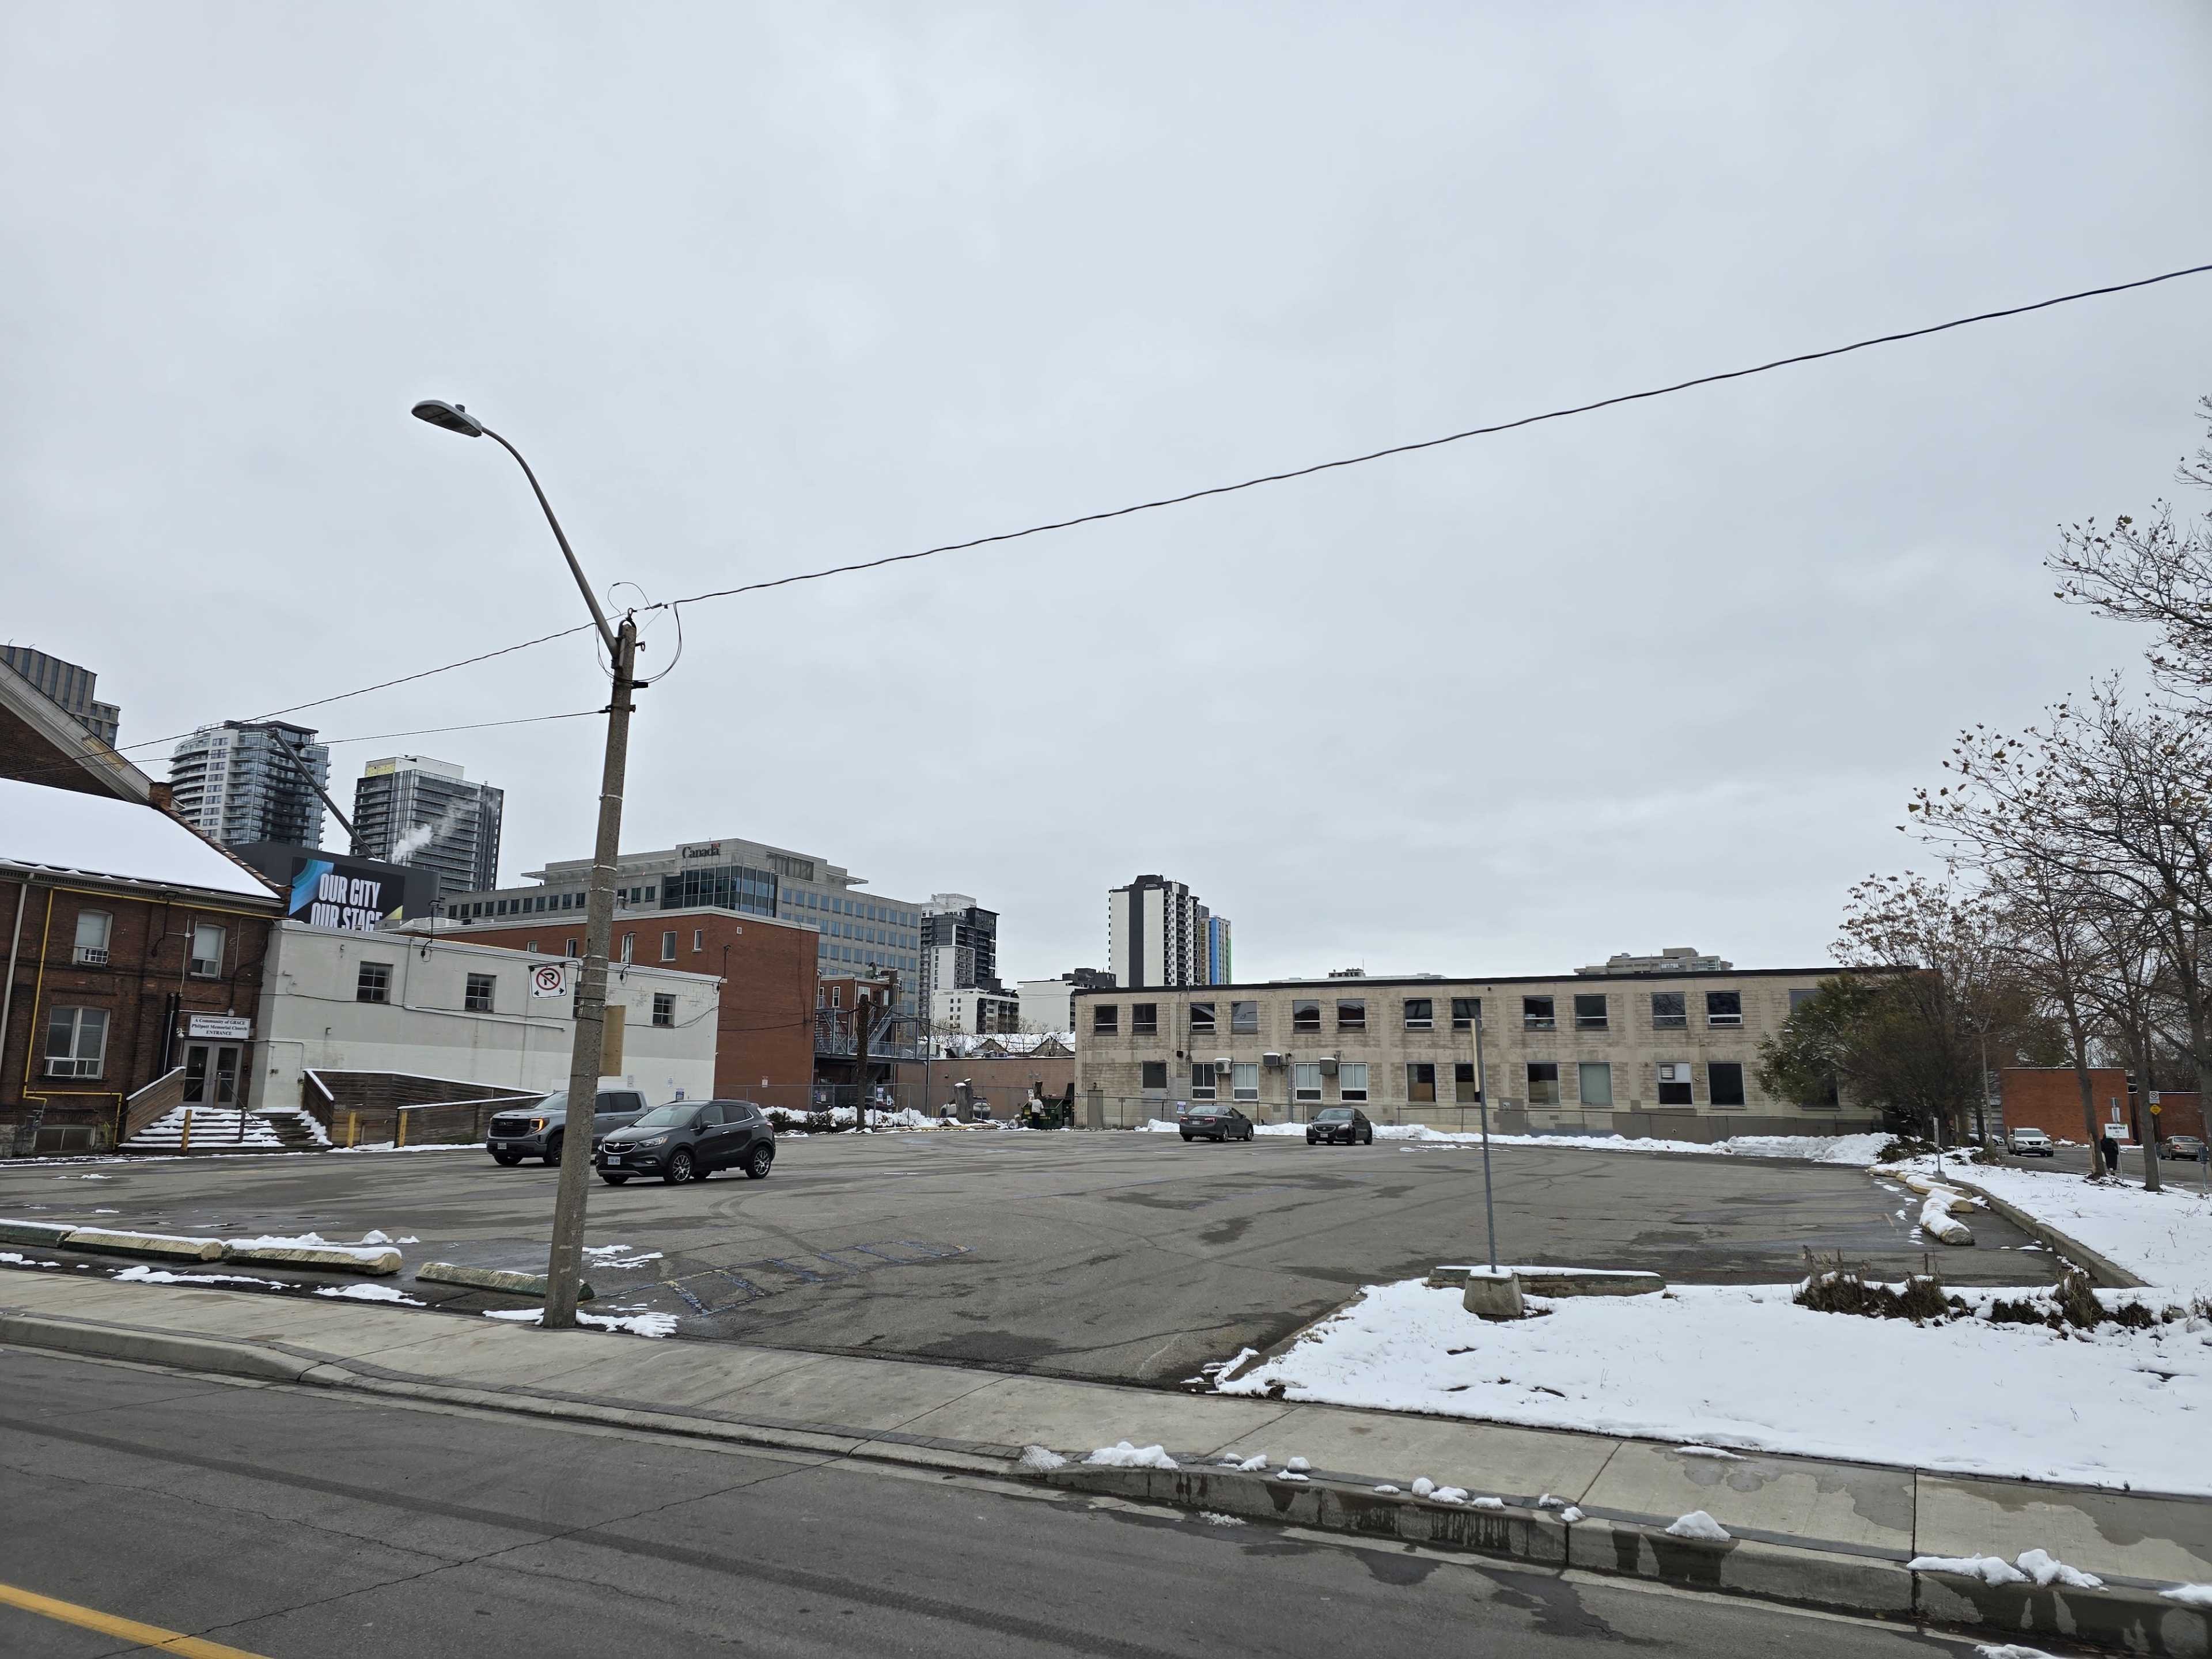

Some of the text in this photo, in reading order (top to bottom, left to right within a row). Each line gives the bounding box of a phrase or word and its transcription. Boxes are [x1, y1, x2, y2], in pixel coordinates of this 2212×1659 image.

[682, 843, 720, 858] Canada
[319, 873, 381, 908] OUR CITY
[310, 902, 340, 928] OUR
